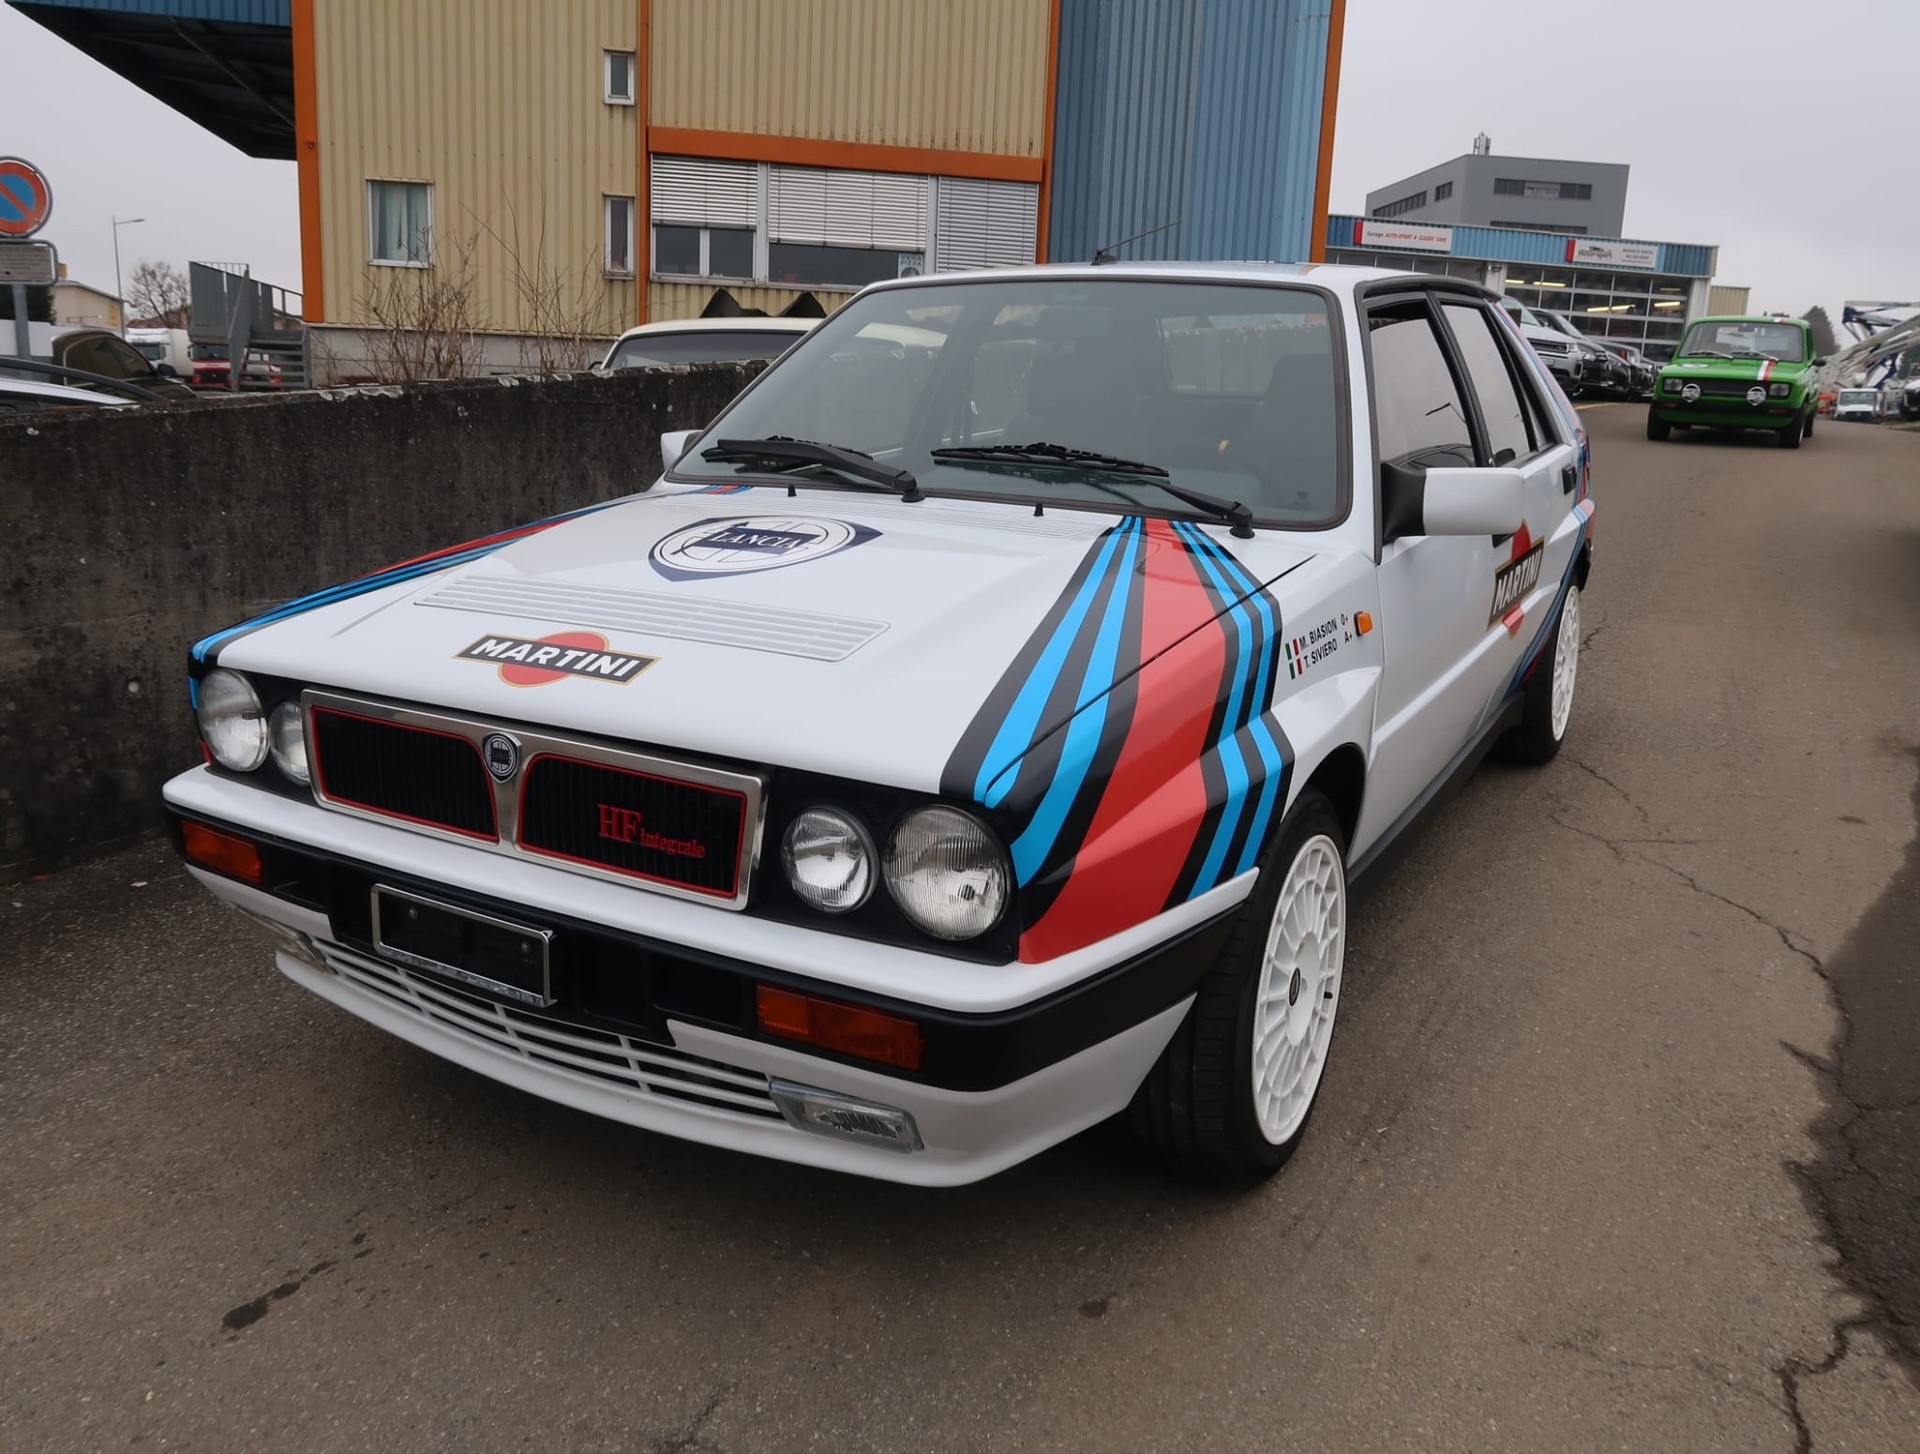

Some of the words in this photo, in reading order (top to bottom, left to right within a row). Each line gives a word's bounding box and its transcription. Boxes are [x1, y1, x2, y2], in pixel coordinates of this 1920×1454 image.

[709, 531, 802, 550] LANCIA
[1492, 549, 1542, 616] MARTINI
[1299, 635, 1309, 651] M.
[1309, 617, 1337, 645] BIASION
[1303, 655, 1310, 668] T.
[1311, 638, 1338, 665] SIVIERO
[1344, 630, 1352, 643] A+
[470, 638, 640, 677] MARTINI
[597, 803, 643, 843] HF
[639, 828, 706, 858] integrale
